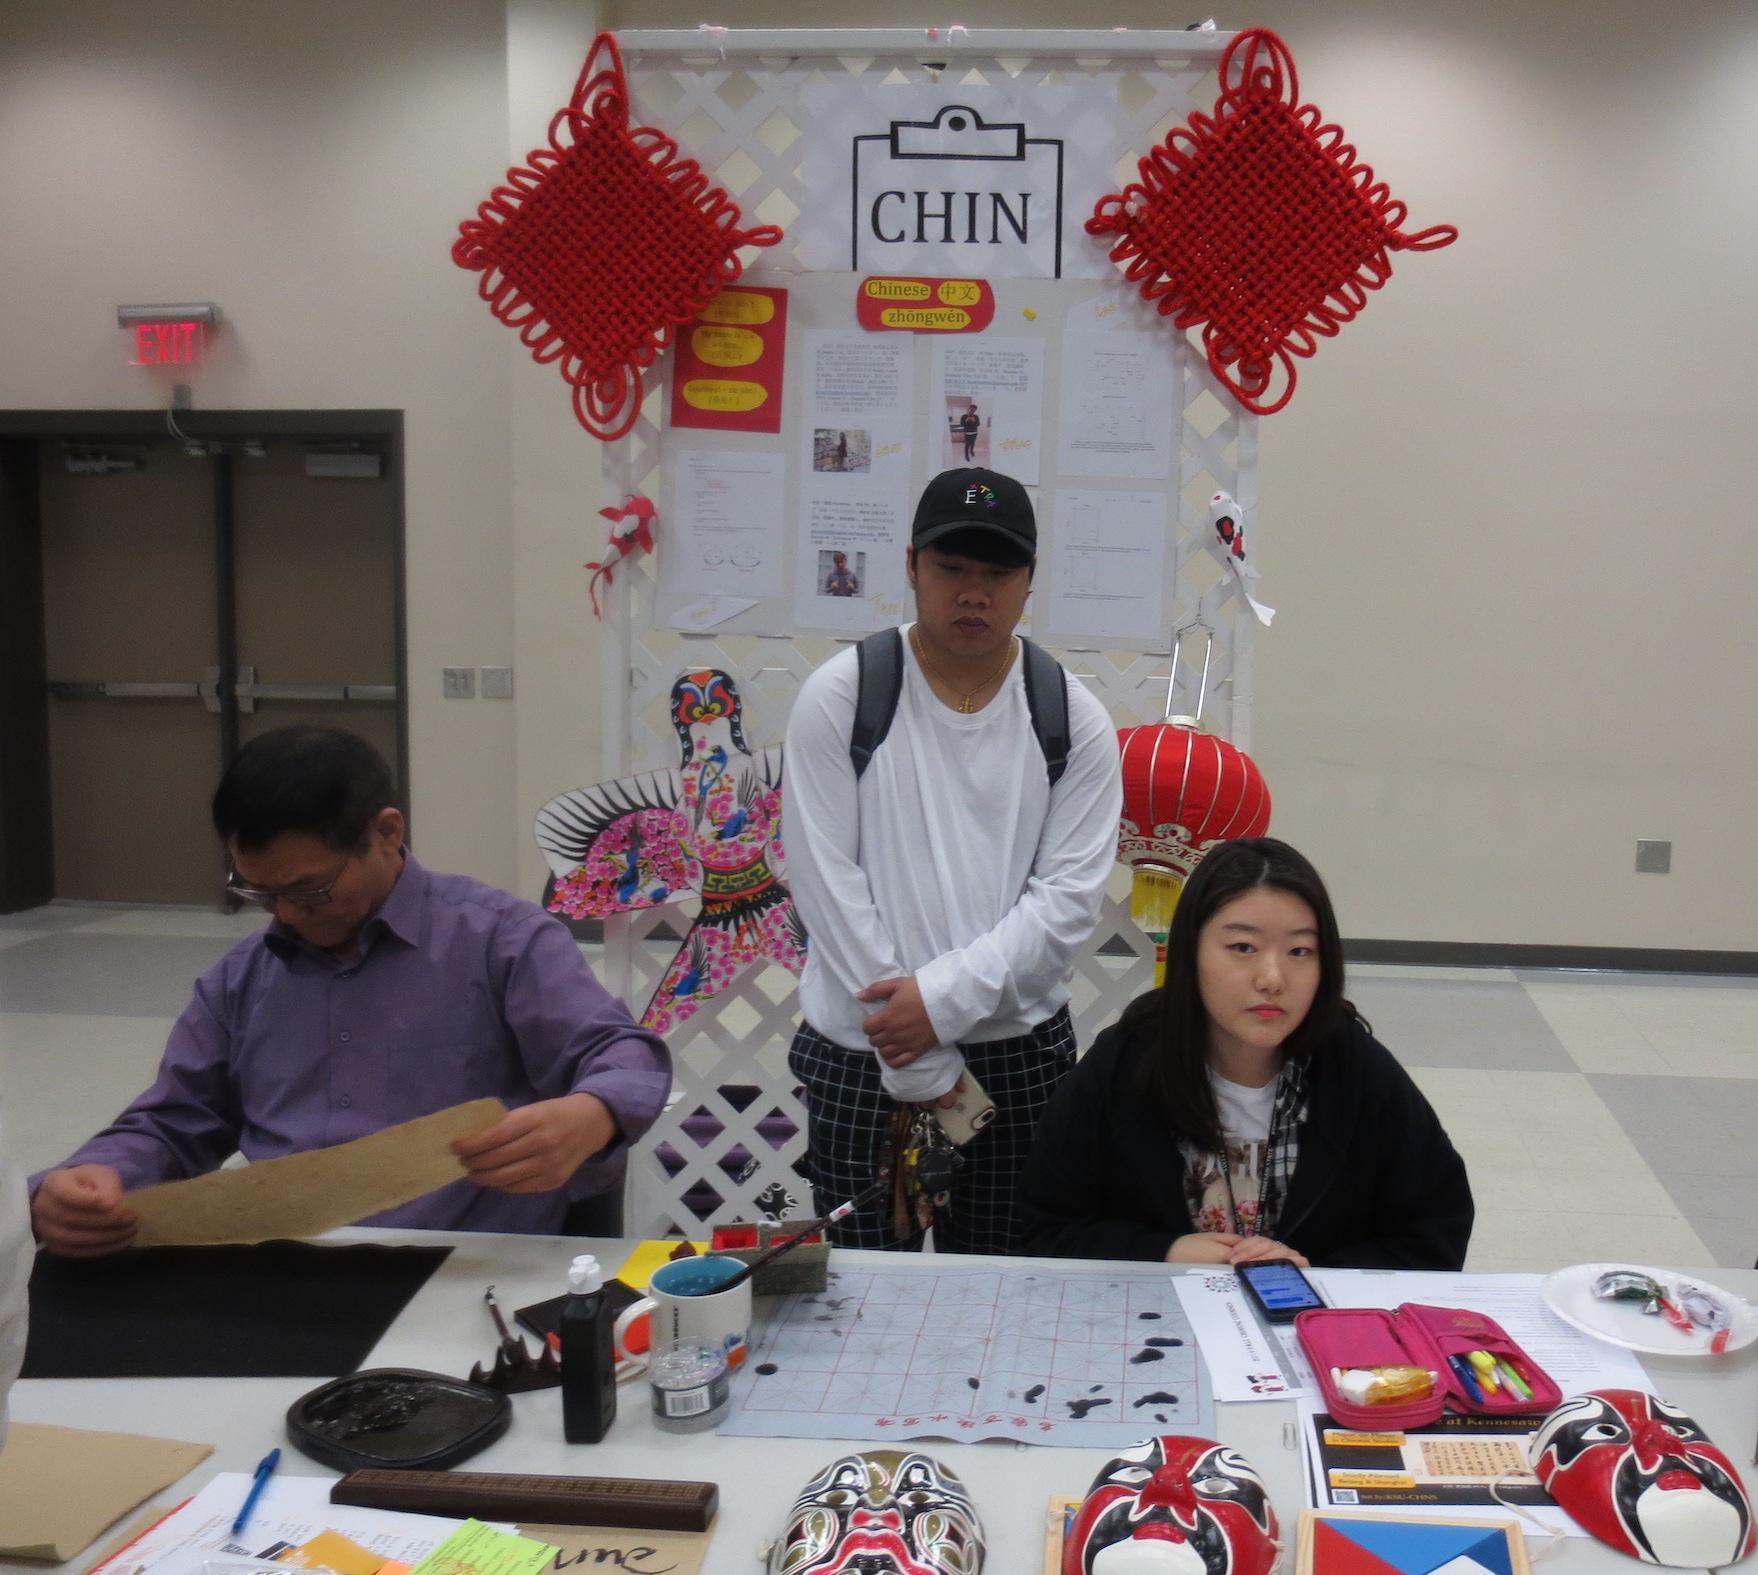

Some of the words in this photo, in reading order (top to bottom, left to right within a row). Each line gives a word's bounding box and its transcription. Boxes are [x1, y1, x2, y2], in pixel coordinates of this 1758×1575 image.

[871, 190, 1032, 244] CHIN
[867, 281, 929, 297] Chinese
[940, 283, 976, 301] 中文
[888, 308, 965, 327] zhōngwén
[136, 323, 196, 364] EXIT
